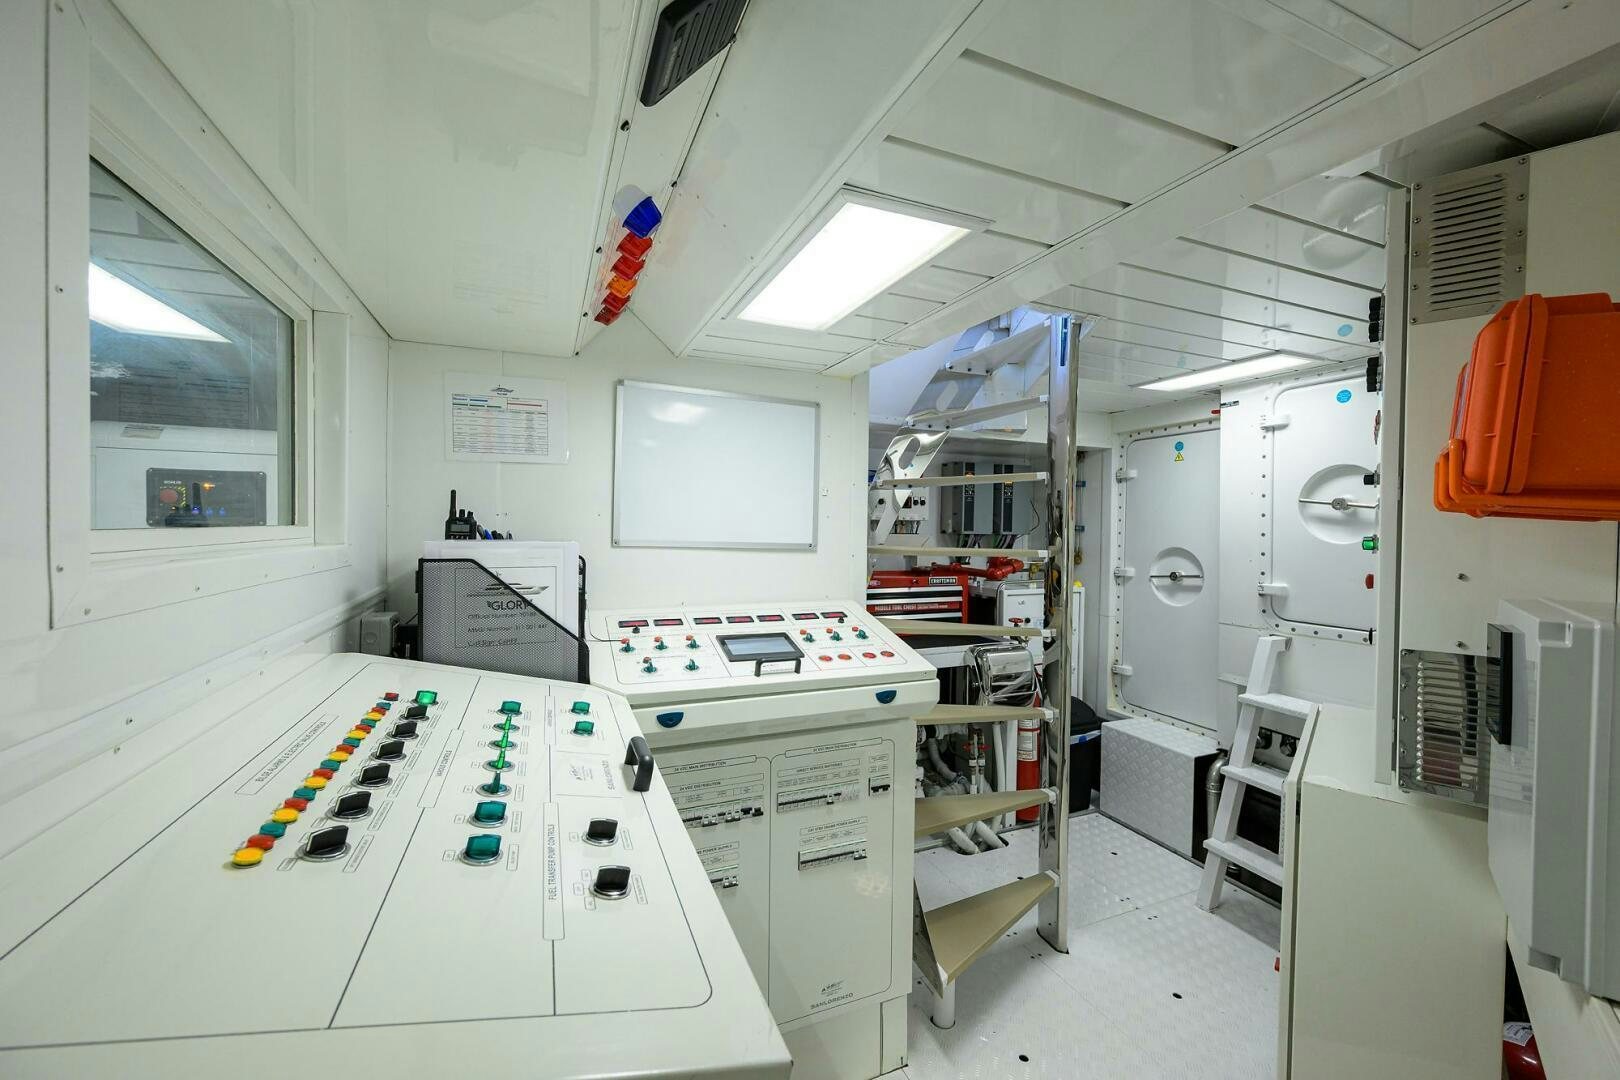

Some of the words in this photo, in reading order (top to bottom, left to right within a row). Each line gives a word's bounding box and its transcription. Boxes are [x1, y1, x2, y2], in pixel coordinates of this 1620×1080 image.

[547, 824, 555, 846] CONTROLS
[547, 859, 556, 885] TRANSFER
[548, 886, 557, 900] FUEL
[810, 992, 854, 1010] SANLORENZO
